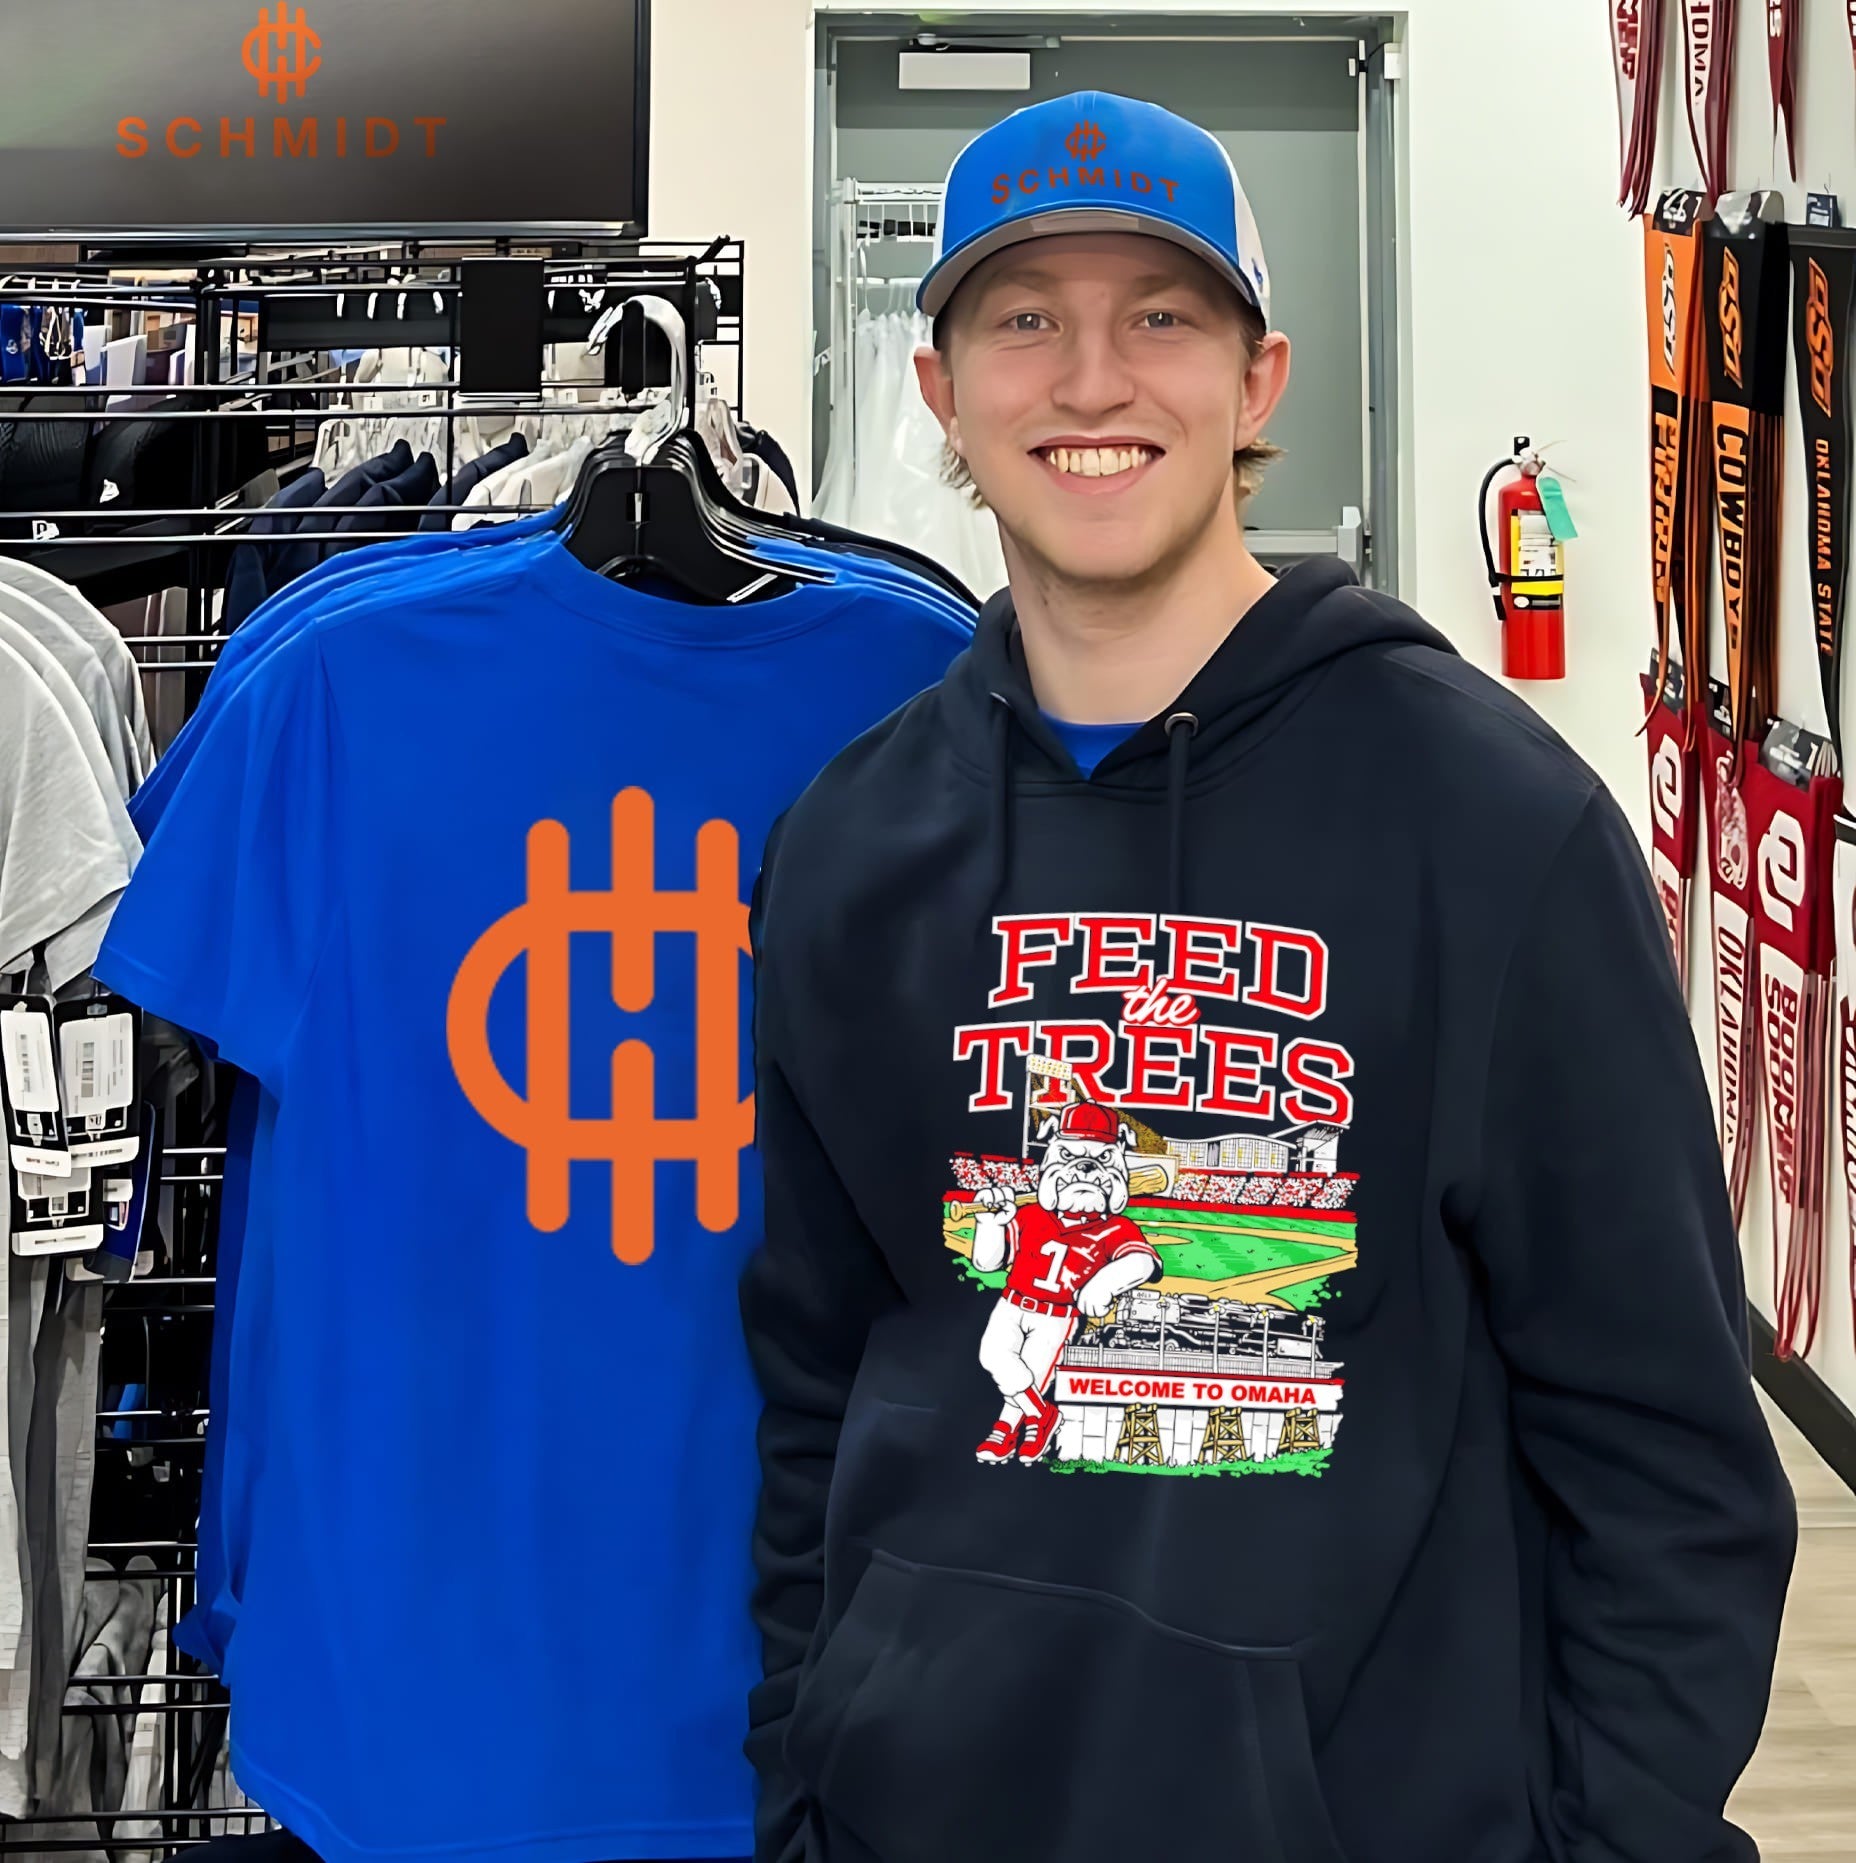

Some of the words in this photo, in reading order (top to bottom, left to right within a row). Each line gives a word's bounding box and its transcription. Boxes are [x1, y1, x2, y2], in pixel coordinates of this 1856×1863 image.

[115, 116, 447, 158] SCHMIDT
[991, 167, 1179, 204] SCHMIDT
[1815, 439, 1833, 570] OKLAHOMA
[988, 912, 1328, 1021] FEED
[1122, 978, 1200, 1026] the
[953, 1020, 1355, 1127] TREES
[1719, 926, 1744, 1144] OKLAHOMA
[1069, 1378, 1185, 1400] WELCOME
[1193, 1383, 1223, 1400] TO
[1231, 1386, 1316, 1405] OMAHA
